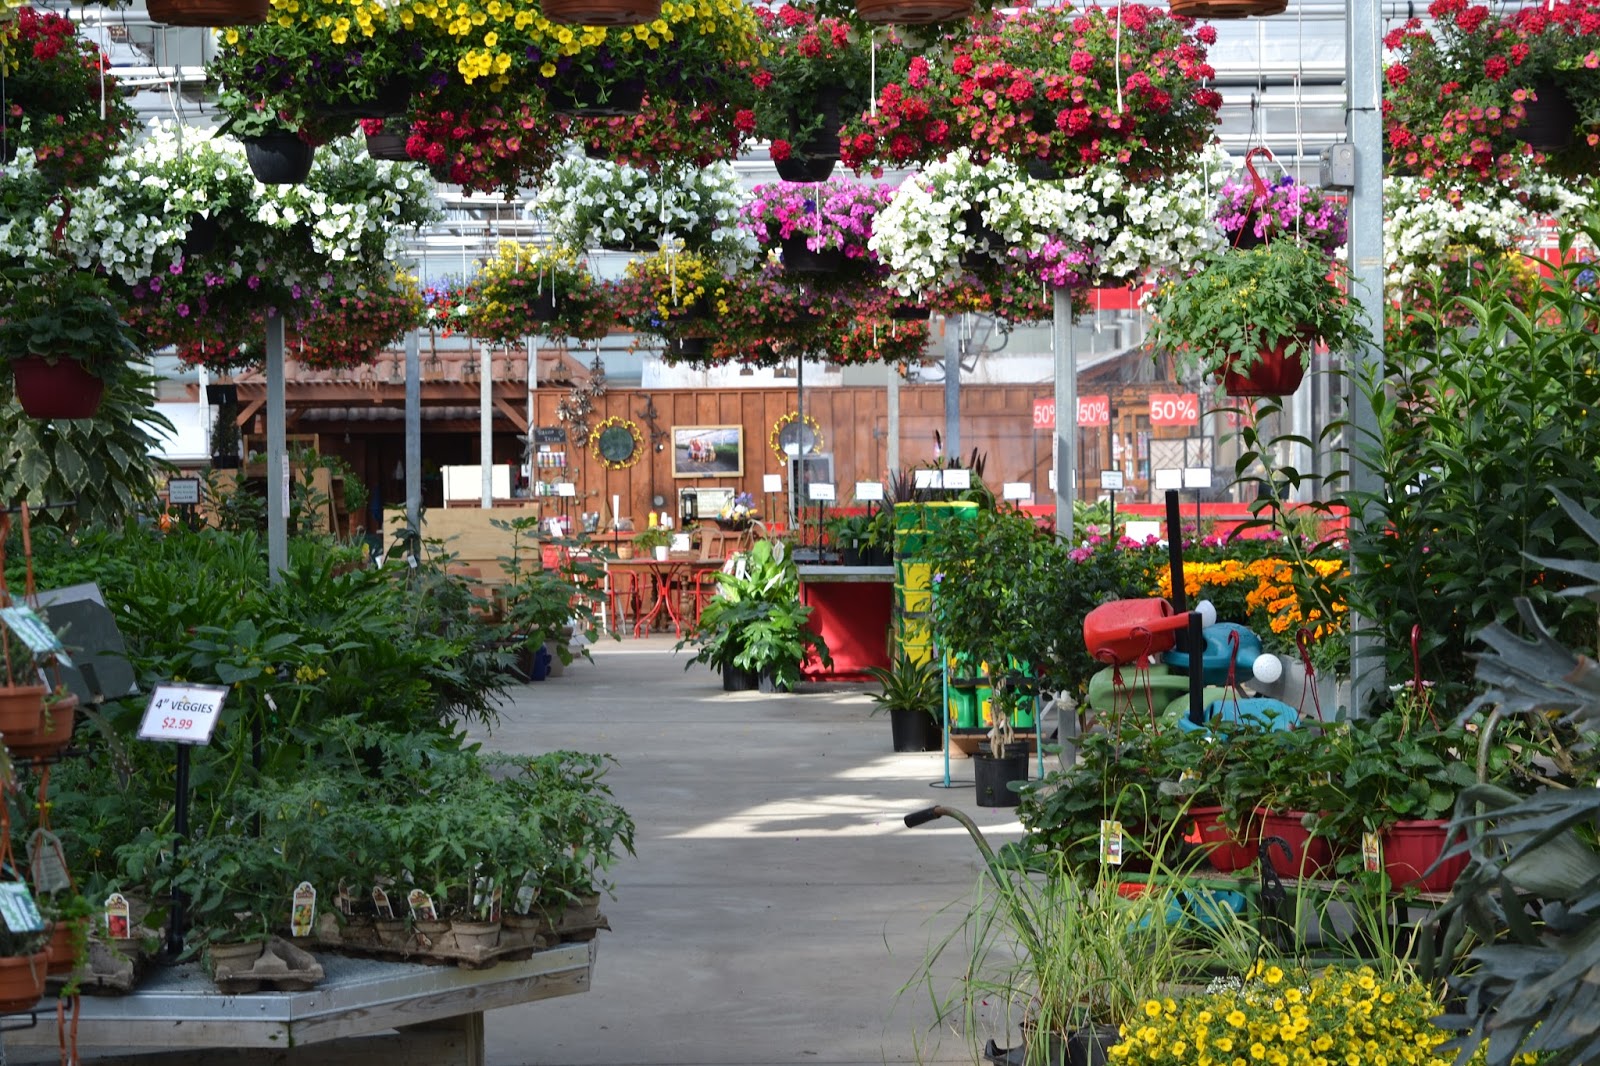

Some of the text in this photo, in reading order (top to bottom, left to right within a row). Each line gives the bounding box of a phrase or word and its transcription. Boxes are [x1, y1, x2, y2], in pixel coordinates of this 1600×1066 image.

[1080, 402, 1109, 422] 50%
[1151, 400, 1196, 420] 50%
[171, 700, 213, 713] VEGGIES
[162, 716, 193, 730] $2.99
